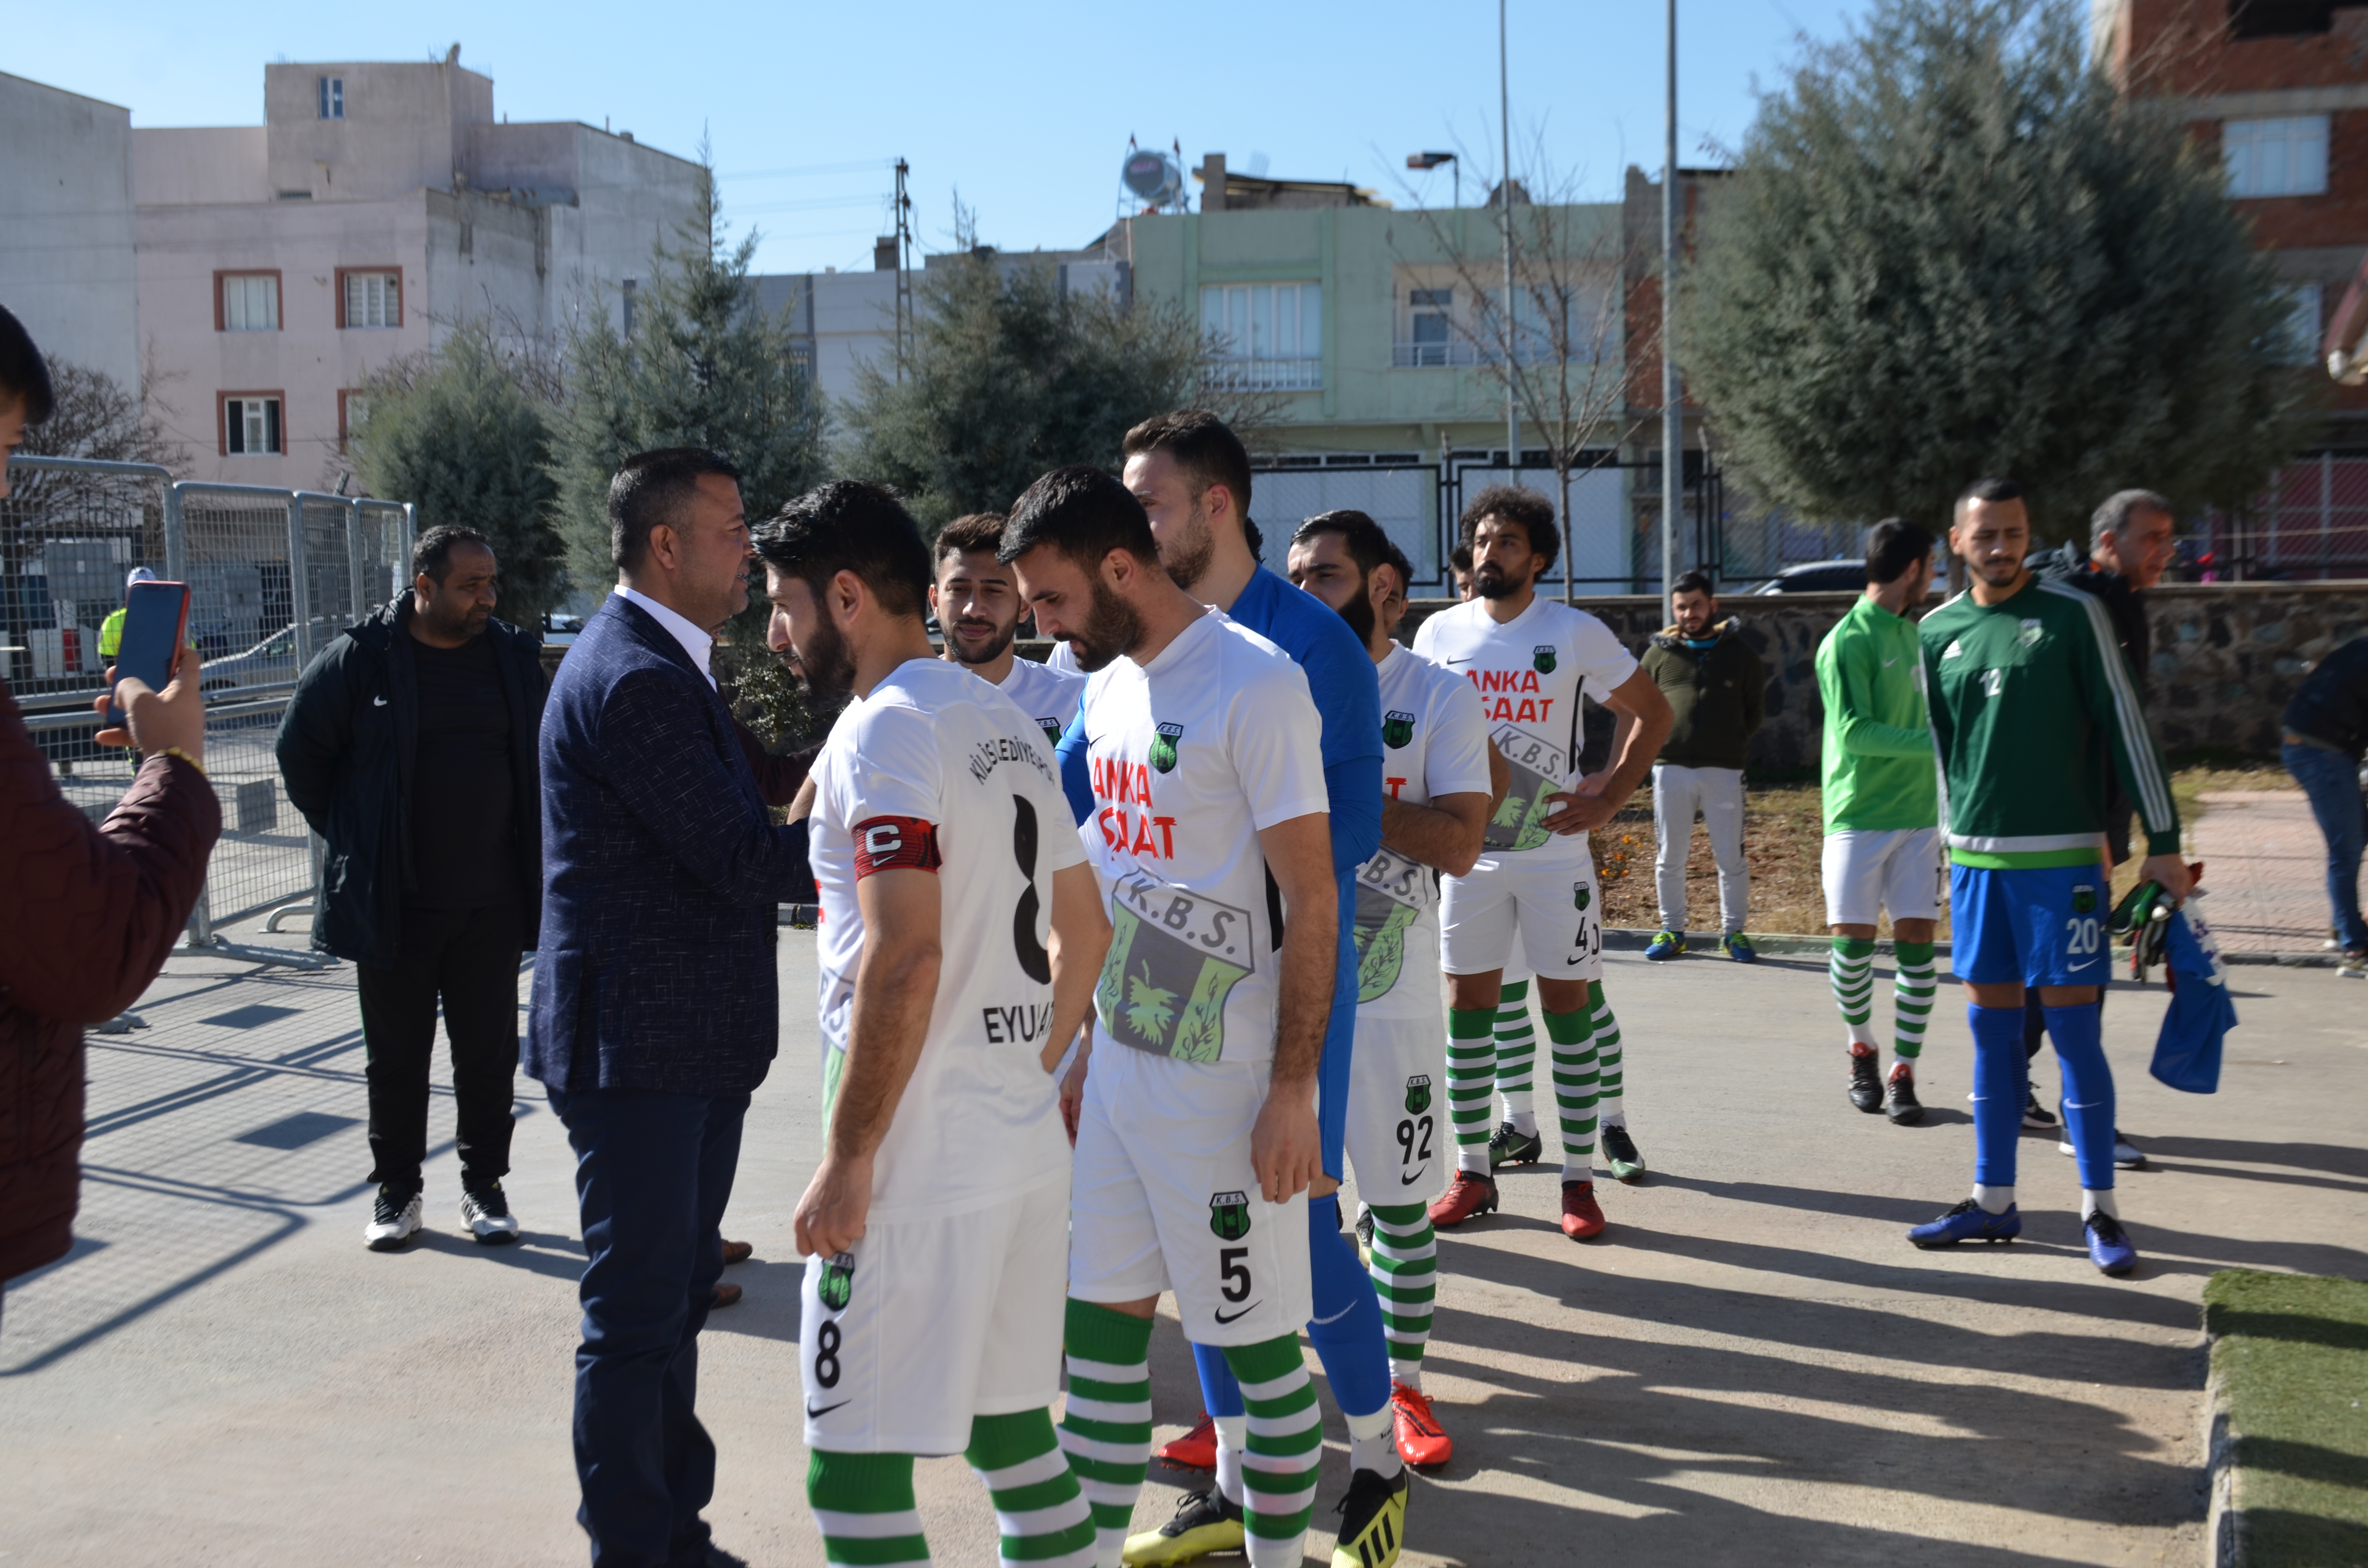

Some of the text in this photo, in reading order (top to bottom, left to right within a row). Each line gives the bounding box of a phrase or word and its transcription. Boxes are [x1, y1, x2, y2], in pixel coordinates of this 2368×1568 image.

[1978, 668, 2001, 697] 12
[1160, 724, 1178, 735] K.B.S.
[1391, 712, 1411, 721] K.B.S.
[1496, 730, 1560, 779] K.B.S.
[1094, 755, 1153, 809] ANKA
[865, 824, 902, 855] C
[1128, 877, 1236, 955] K.B.S.
[2066, 918, 2099, 954] 20
[1410, 1077, 1427, 1086] K.B.S.
[1396, 1115, 1433, 1165] 92
[1216, 1194, 1243, 1205] K.B.S.
[1221, 1247, 1251, 1302] 5
[815, 1320, 841, 1388] 8
